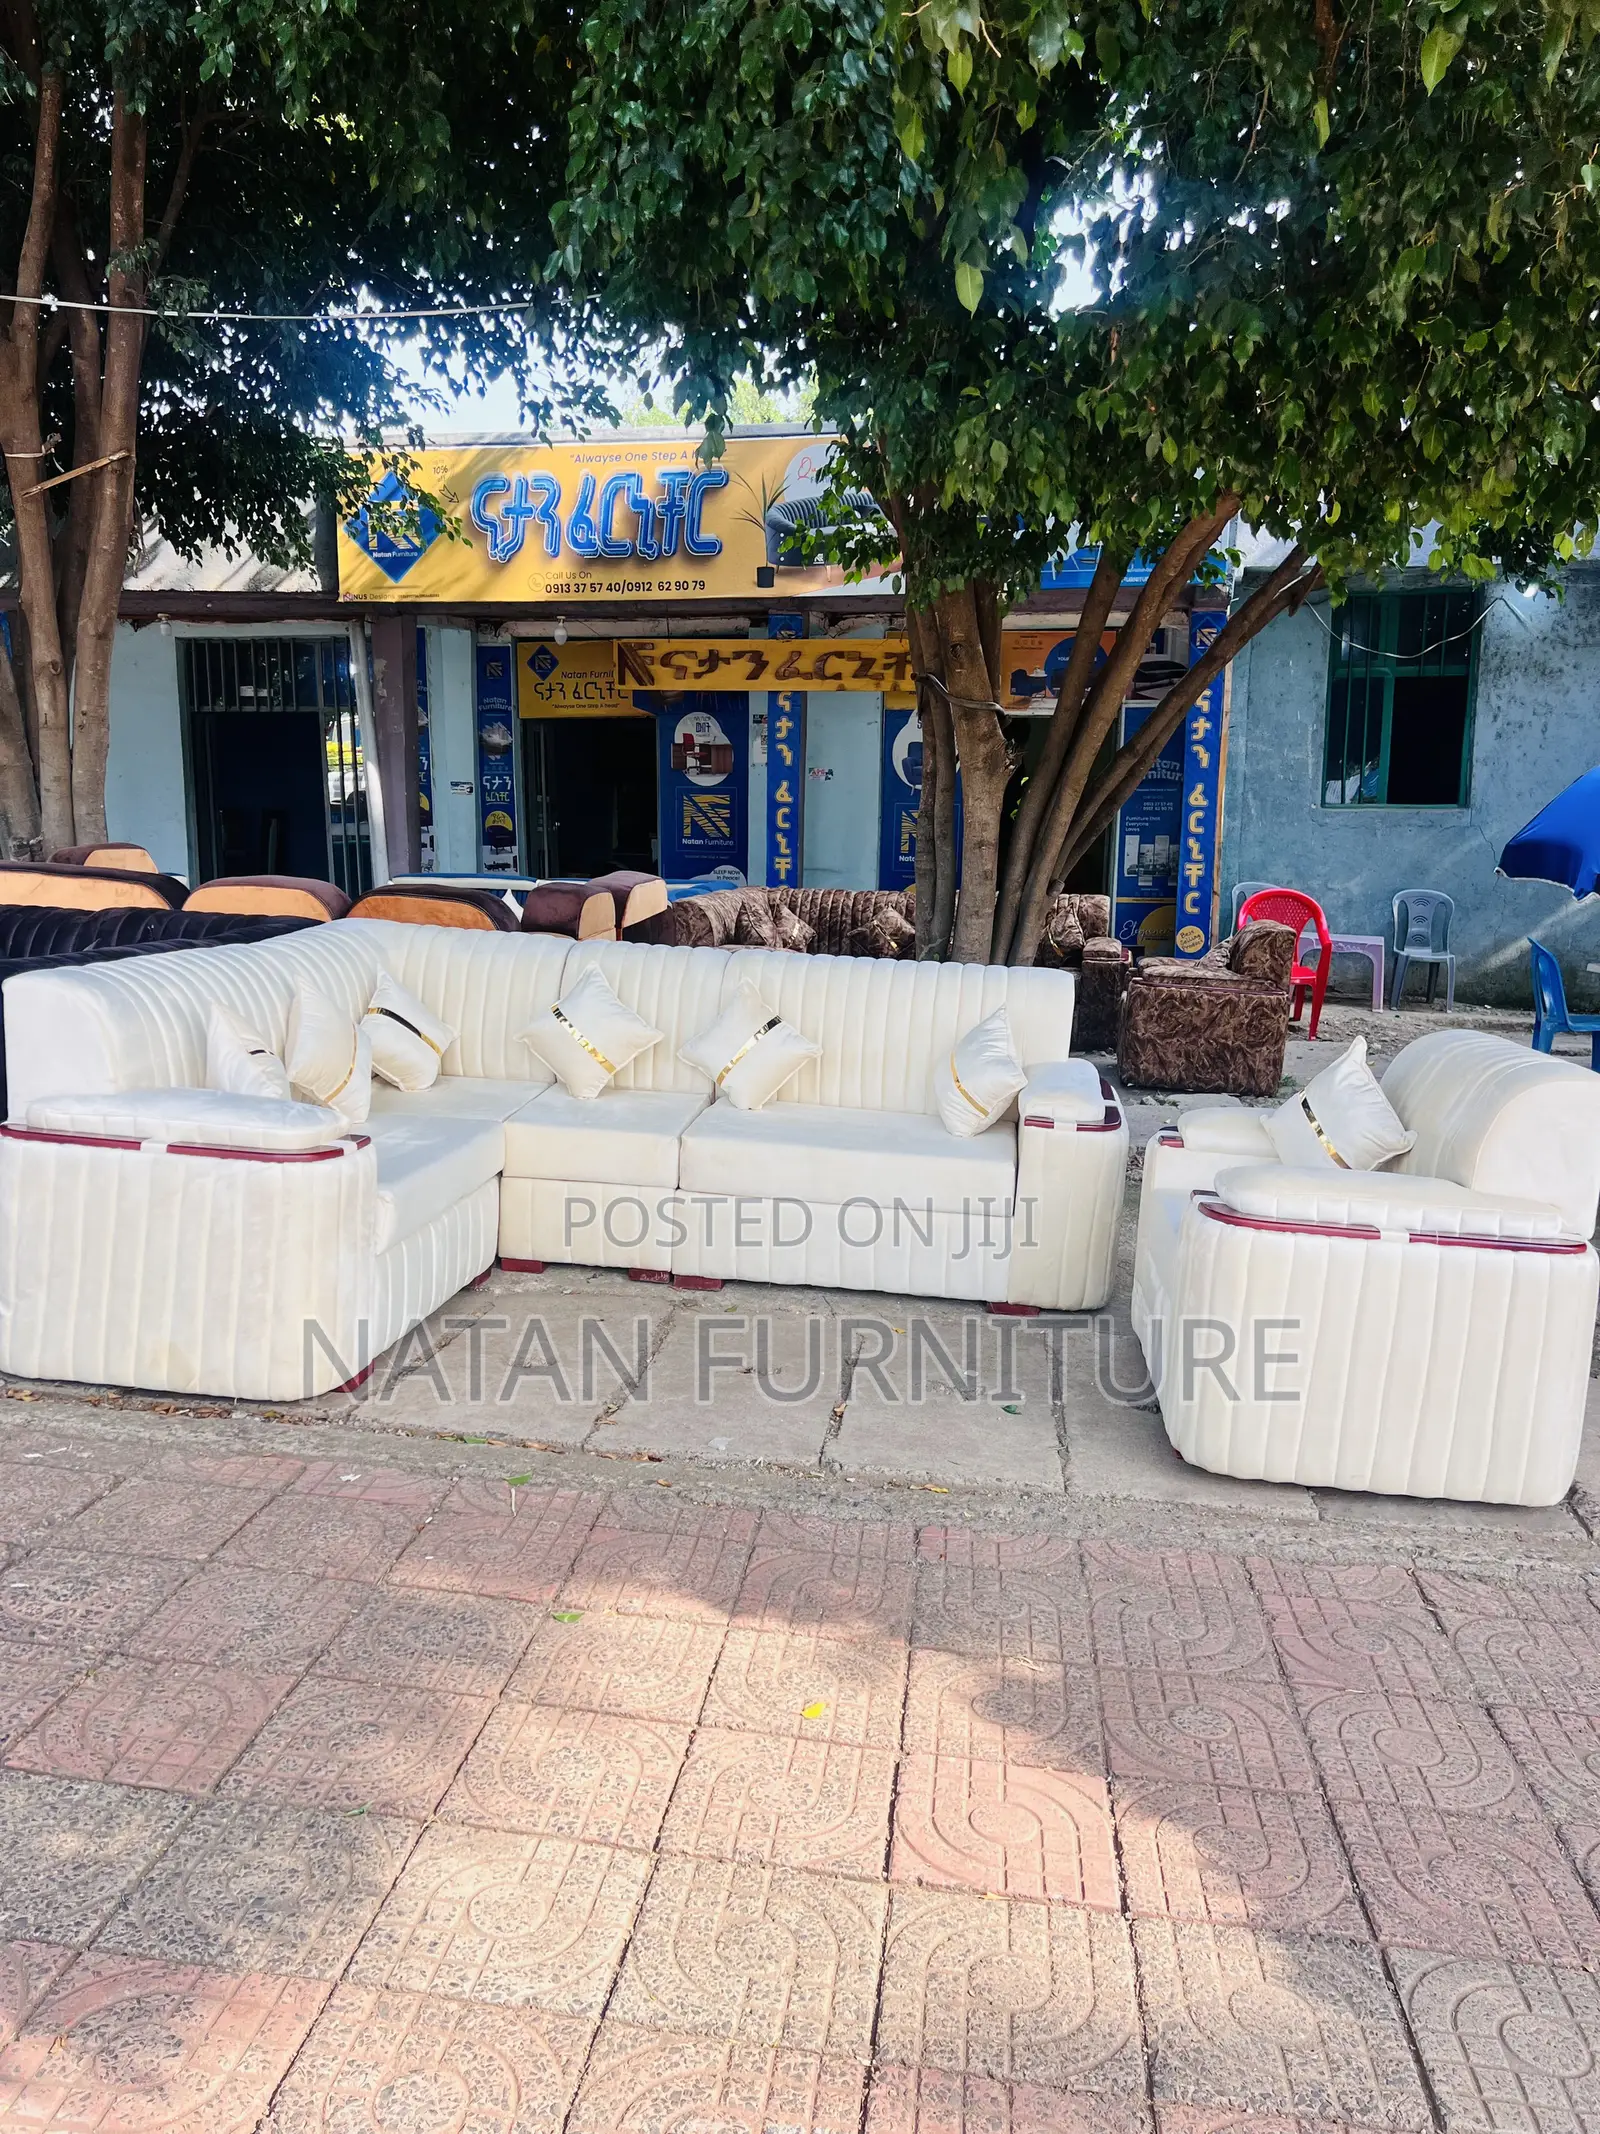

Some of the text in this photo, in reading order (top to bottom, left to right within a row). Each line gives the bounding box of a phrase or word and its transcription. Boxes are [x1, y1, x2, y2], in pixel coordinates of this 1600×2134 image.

[624, 452, 648, 462] One
[651, 451, 677, 463] Step
[680, 450, 688, 460] A
[545, 570, 592, 580] Call Us On
[545, 579, 706, 594] 0913 37 57 40/0912 62 90 79
[561, 670, 588, 679] Natan
[704, 838, 734, 846] Furniture
